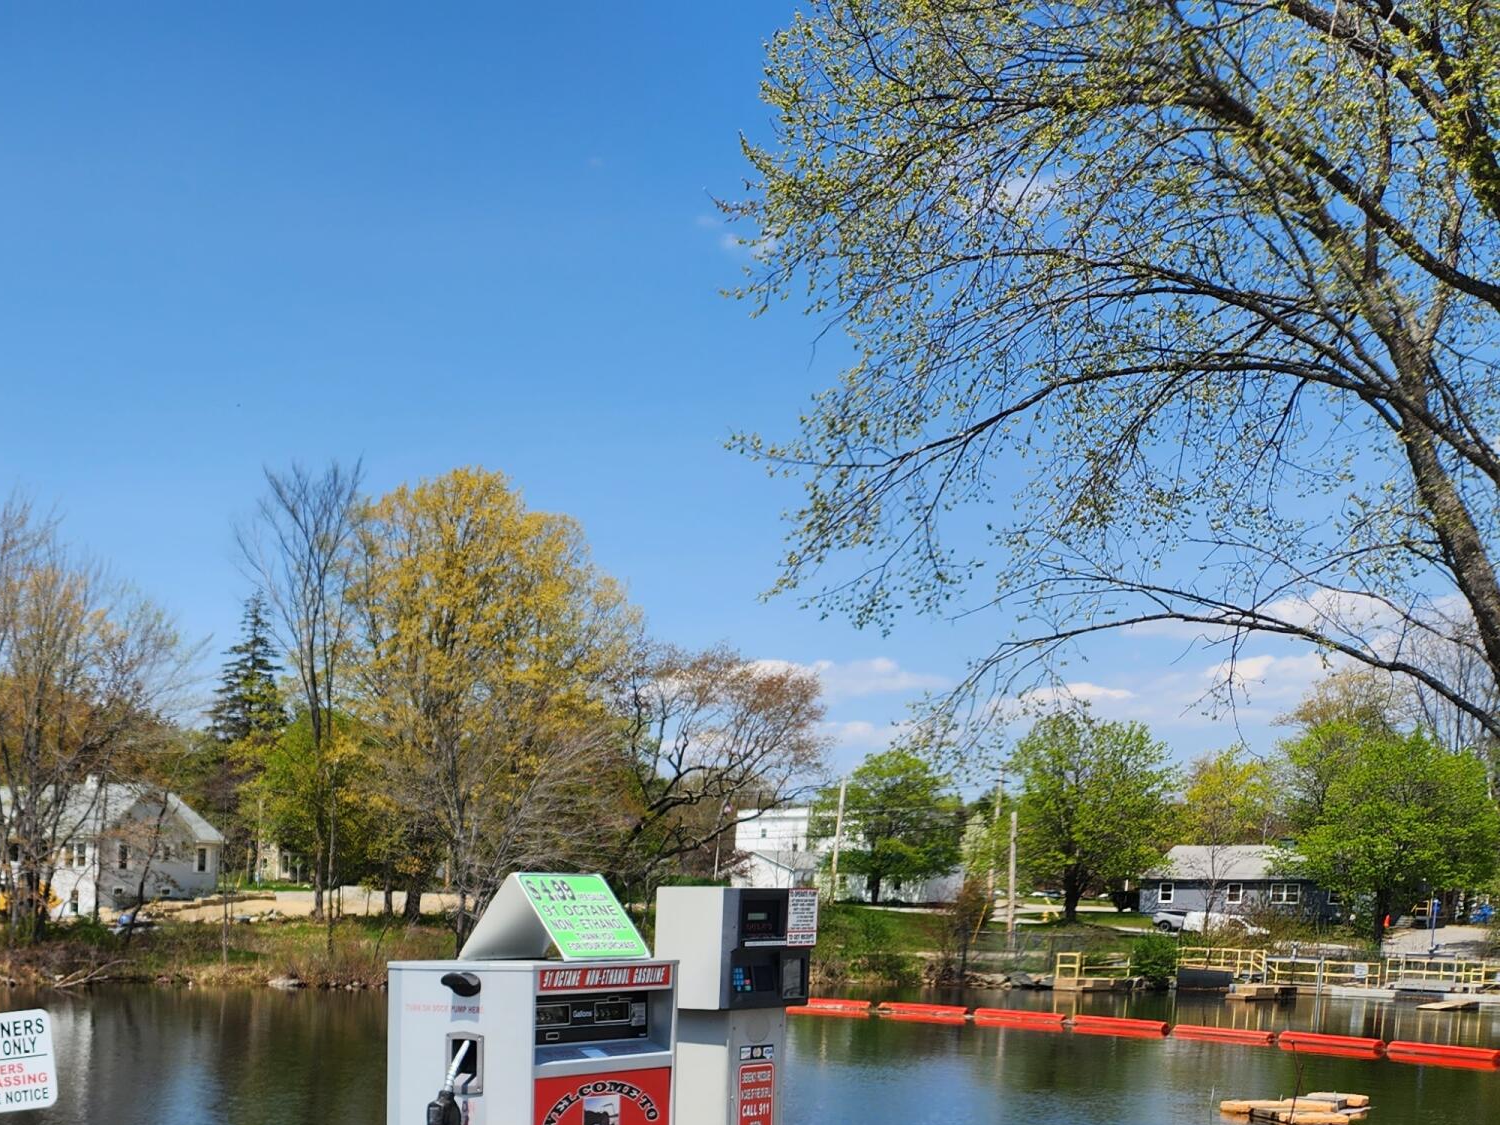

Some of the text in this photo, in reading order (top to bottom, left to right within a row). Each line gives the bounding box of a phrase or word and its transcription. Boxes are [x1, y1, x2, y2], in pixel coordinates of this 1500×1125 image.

[542, 904, 619, 917] 91 OCTANE
[543, 967, 666, 987] 91 OCTANE NON-ETHANOL GASOLINE
[451, 1005, 467, 1013] PUMP
[2, 1037, 37, 1056] ONLY
[5, 1087, 50, 1105] NOTICE
[639, 1095, 659, 1121] TO
[742, 1103, 770, 1117] CALL 911
